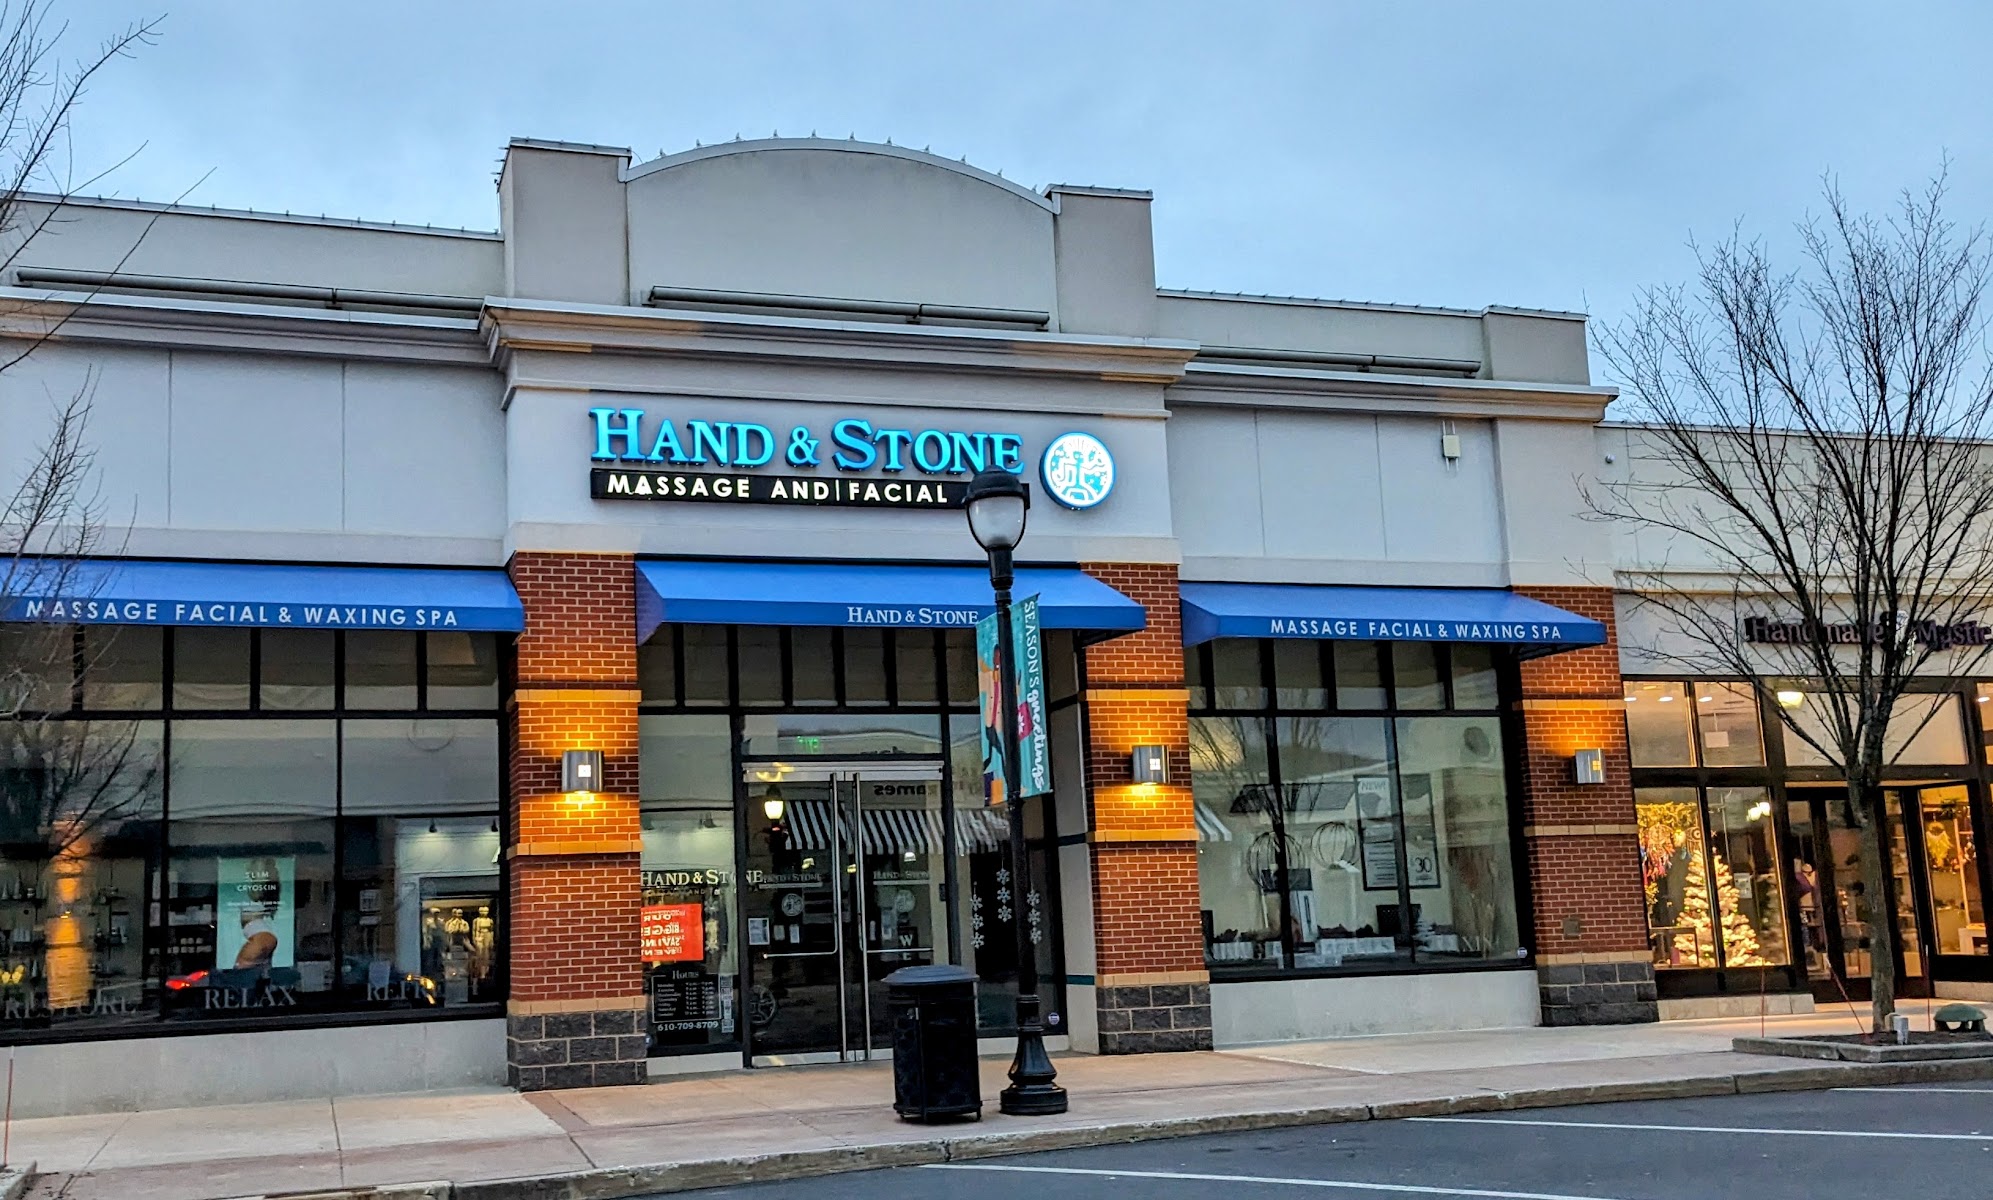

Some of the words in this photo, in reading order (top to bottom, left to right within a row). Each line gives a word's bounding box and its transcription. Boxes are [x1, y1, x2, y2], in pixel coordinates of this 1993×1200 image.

[588, 407, 775, 468] HAND
[785, 426, 821, 467] &
[831, 418, 1025, 474] STONE
[607, 473, 750, 499] MASSAGE
[770, 478, 830, 500] AND
[849, 481, 948, 504] FACIAL
[26, 600, 157, 620] MASSAGE
[175, 604, 268, 623] FACIAL
[278, 606, 292, 623] &
[304, 607, 406, 626] WAXING
[415, 608, 458, 626] SPA
[847, 606, 902, 624] HAND
[905, 610, 916, 623] &
[919, 608, 979, 625] STONE
[1270, 618, 1358, 636] MASSAGE
[1369, 621, 1432, 638] FACIAL
[1438, 623, 1449, 638] &
[1455, 622, 1526, 639] WAXING
[1532, 624, 1562, 640] SPA
[1024, 600, 1040, 689] SEASON'S
[1415, 857, 1433, 873] 30
[641, 870, 690, 887] HAND
[693, 871, 703, 884] &
[204, 984, 297, 1010] RELAX
[657, 1020, 719, 1031] 610-709-8709
